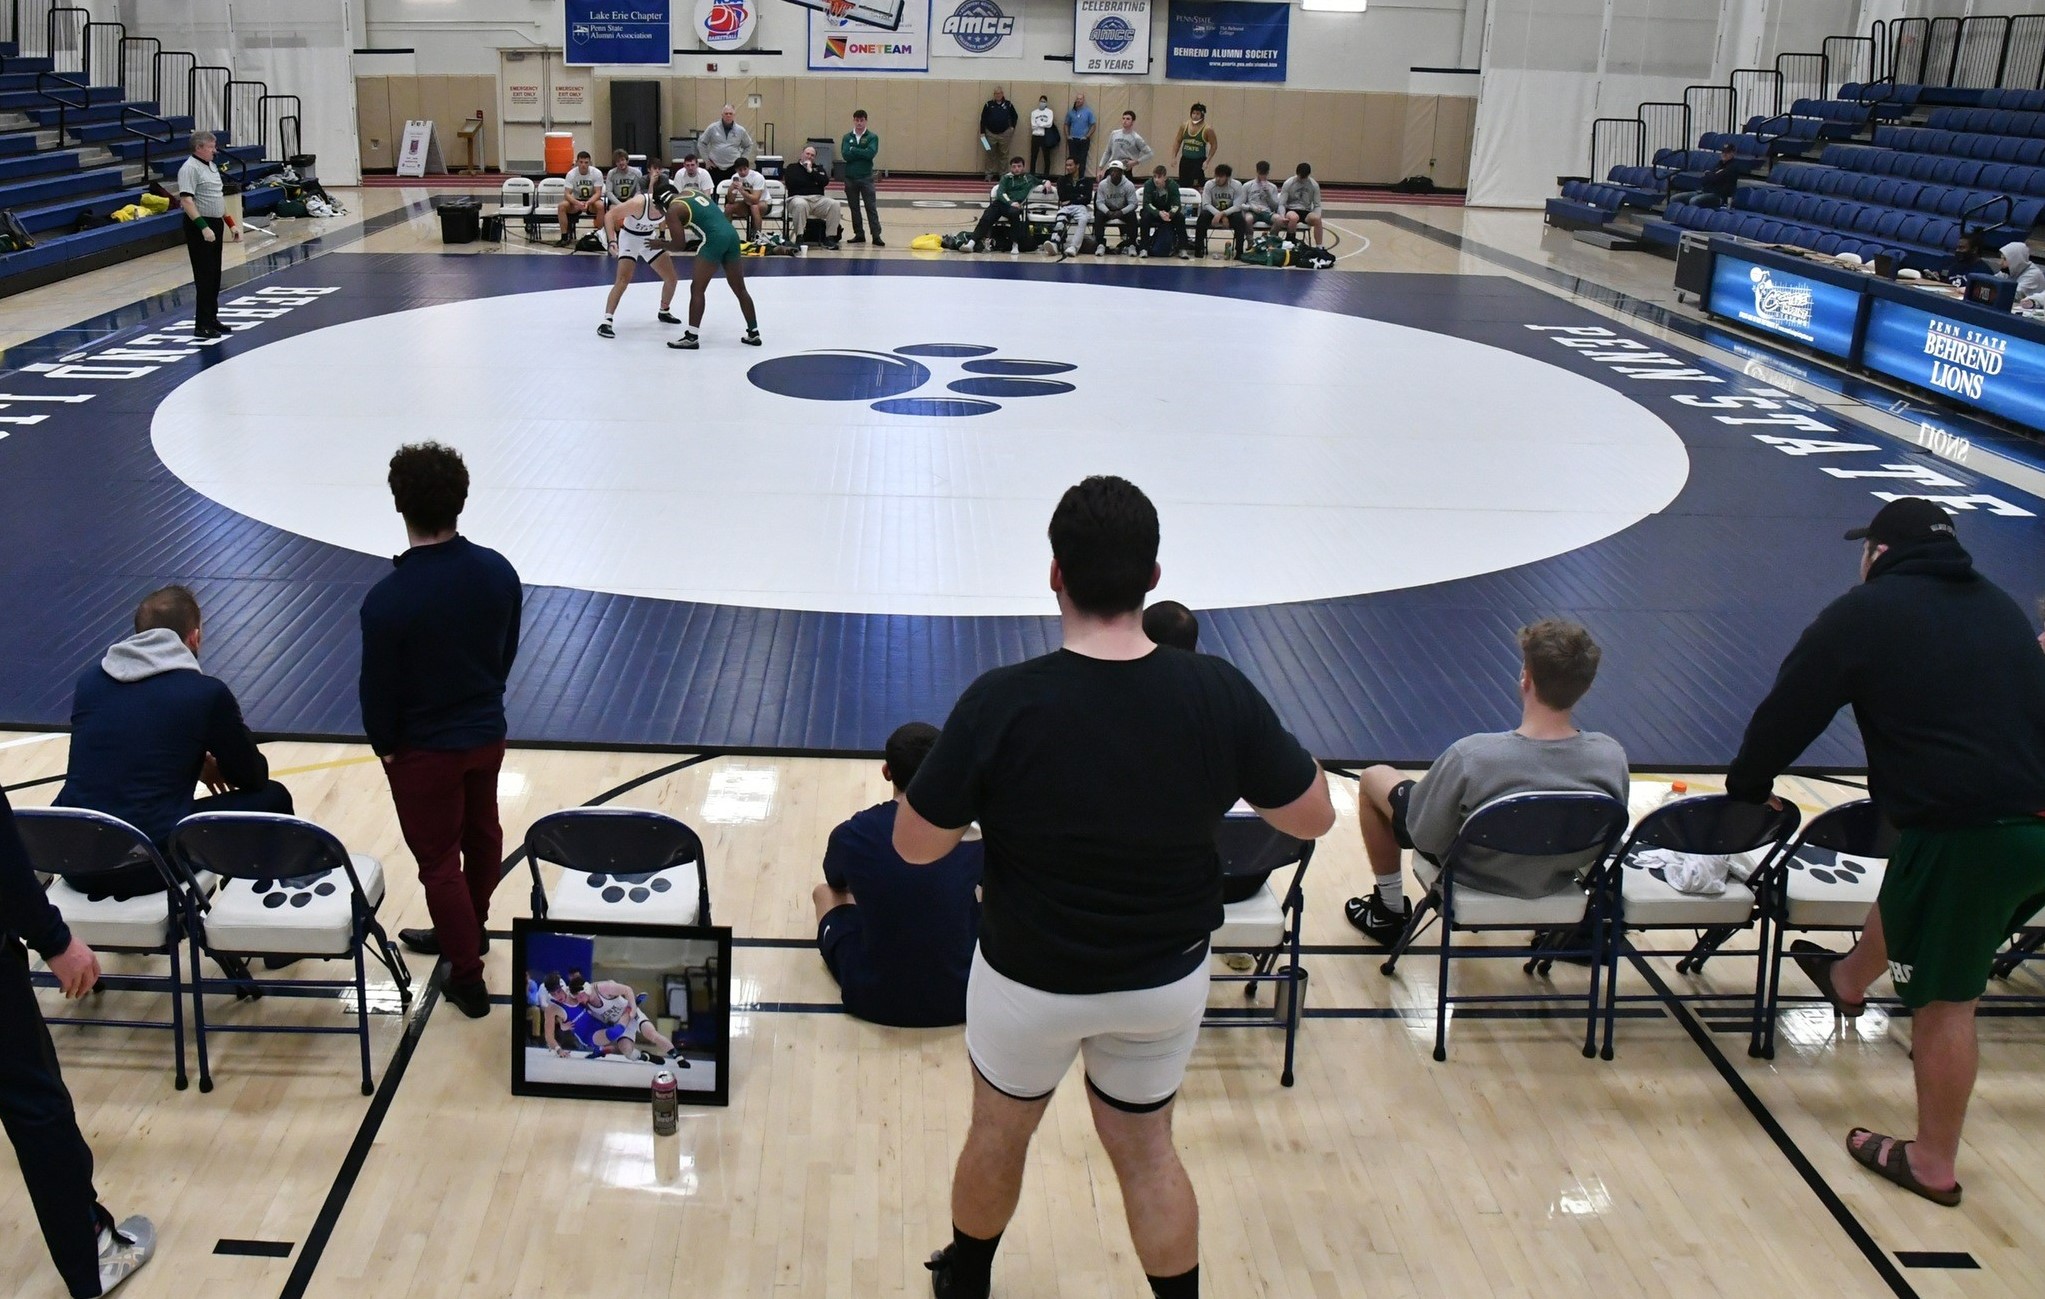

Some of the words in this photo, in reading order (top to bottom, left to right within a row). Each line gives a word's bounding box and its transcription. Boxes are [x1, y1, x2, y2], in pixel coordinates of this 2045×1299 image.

[1082, 1, 1146, 12] CELEBRATING
[590, 11, 610, 20] Lake
[612, 11, 629, 20] Erie
[631, 11, 663, 22] Chapter
[943, 16, 1014, 35] AMCC
[1089, 29, 1136, 41] AMCC
[849, 44, 912, 54] ONETEAM
[1173, 47, 1209, 58] BEHREND
[1211, 49, 1243, 58] ALUMNI
[1245, 50, 1278, 59] SOCIETY
[1088, 59, 1102, 69] 25
[1104, 59, 1135, 70] YEARS
[1929, 319, 1960, 337] PENN
[1966, 330, 2007, 351] STATE
[1524, 324, 1726, 383] PENN
[1923, 332, 2003, 376] BEHREND
[1930, 360, 1985, 400] LIONS
